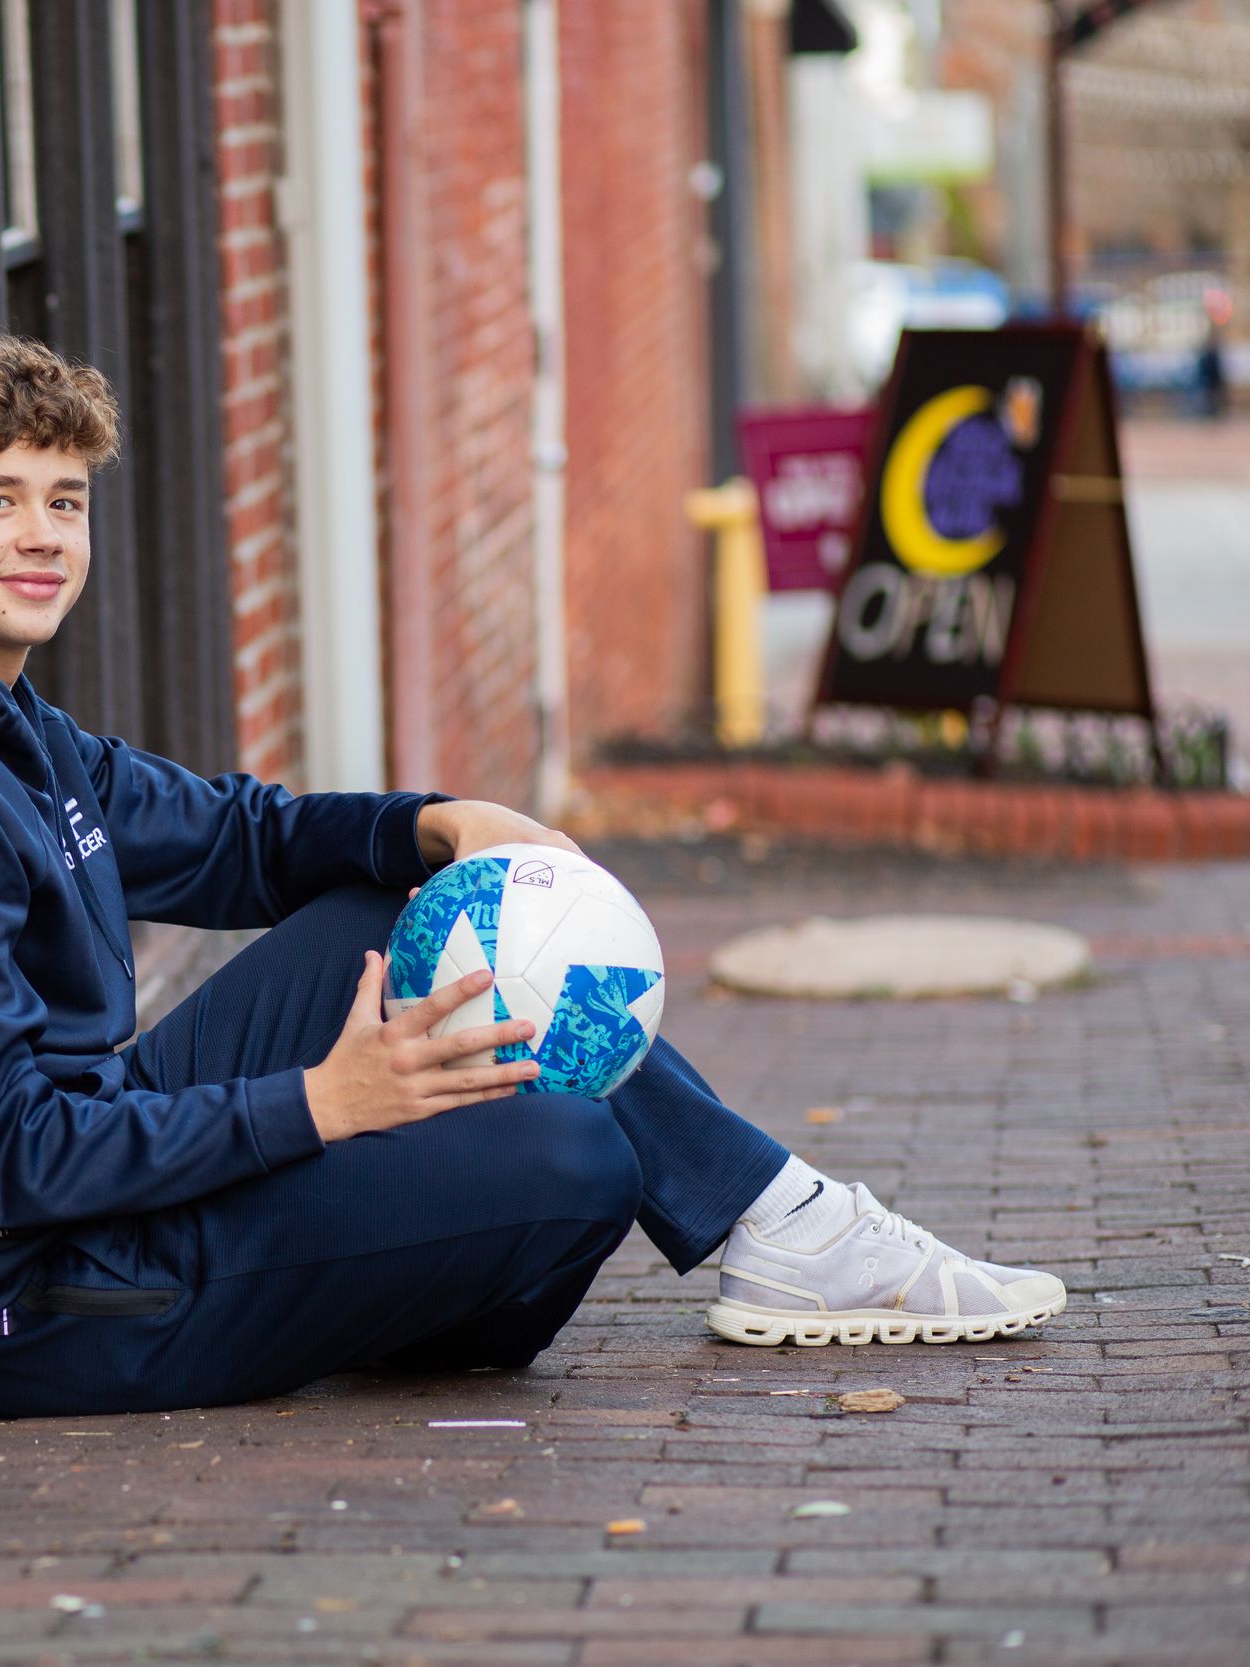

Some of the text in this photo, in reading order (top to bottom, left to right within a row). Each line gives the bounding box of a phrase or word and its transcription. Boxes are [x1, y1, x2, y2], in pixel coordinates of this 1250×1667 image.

[839, 563, 1016, 667] OPEN
[64, 827, 107, 870] OCER
[529, 877, 549, 886] MLS
